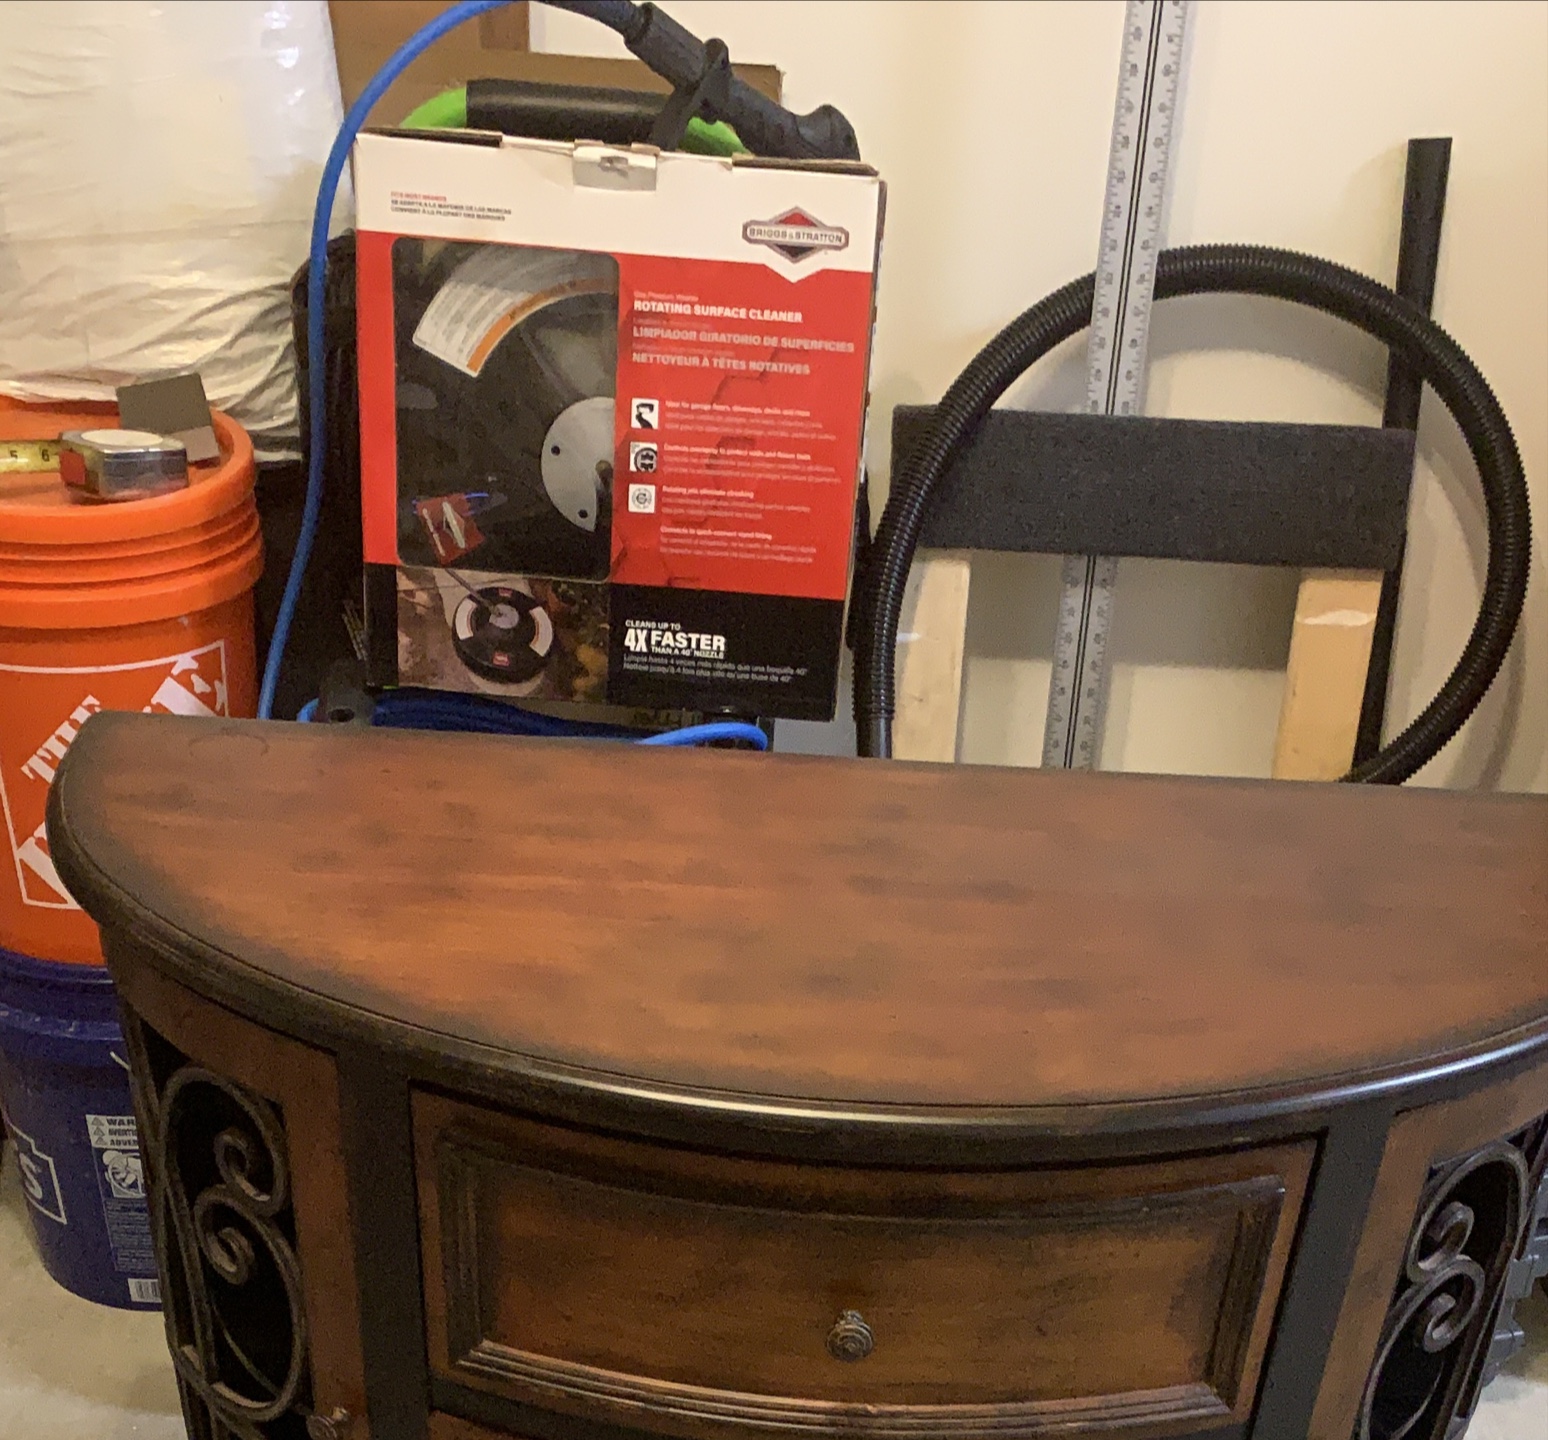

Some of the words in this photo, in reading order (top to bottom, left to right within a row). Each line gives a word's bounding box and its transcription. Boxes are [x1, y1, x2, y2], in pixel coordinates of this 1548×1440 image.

[633, 299, 692, 315] ROTATING
[693, 305, 747, 320] SURFACE
[748, 308, 803, 323] CLEANER
[632, 326, 697, 342] LIMPIADOR
[10, 450, 18, 460] 5
[41, 449, 50, 462] 6
[625, 619, 657, 629] CLEANS
[657, 621, 669, 630] UP
[670, 622, 681, 631] TO
[624, 628, 648, 653] 4X
[650, 630, 726, 651] FASTER
